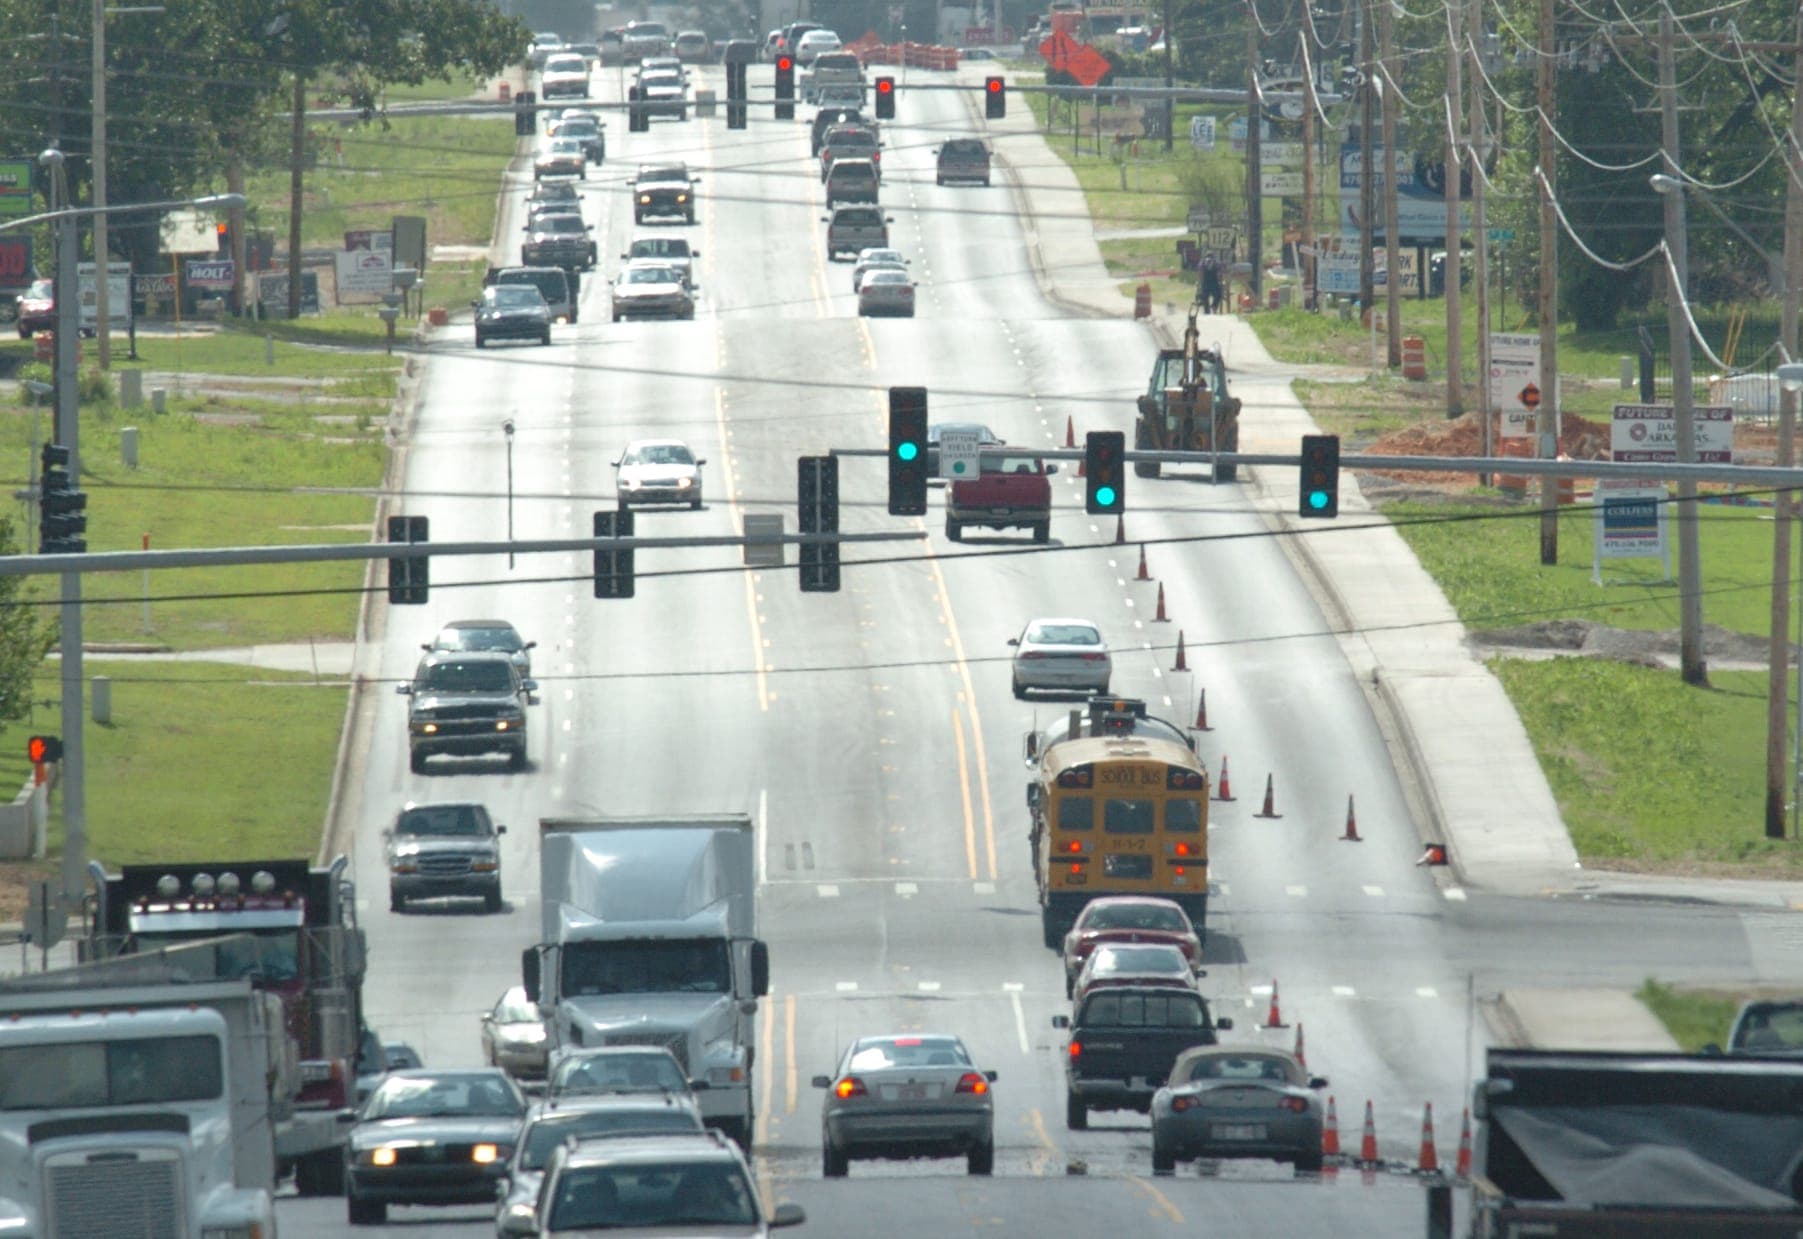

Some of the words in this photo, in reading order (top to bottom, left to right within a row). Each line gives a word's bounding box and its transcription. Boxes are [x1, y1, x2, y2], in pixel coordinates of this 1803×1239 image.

[1212, 231, 1231, 244] 112
[190, 266, 226, 280] HOLT
[1617, 407, 1669, 419] FUTURE
[948, 443, 973, 451] YIELD
[1102, 766, 1136, 786] SCHOOL
[1141, 766, 1160, 786] BUS
